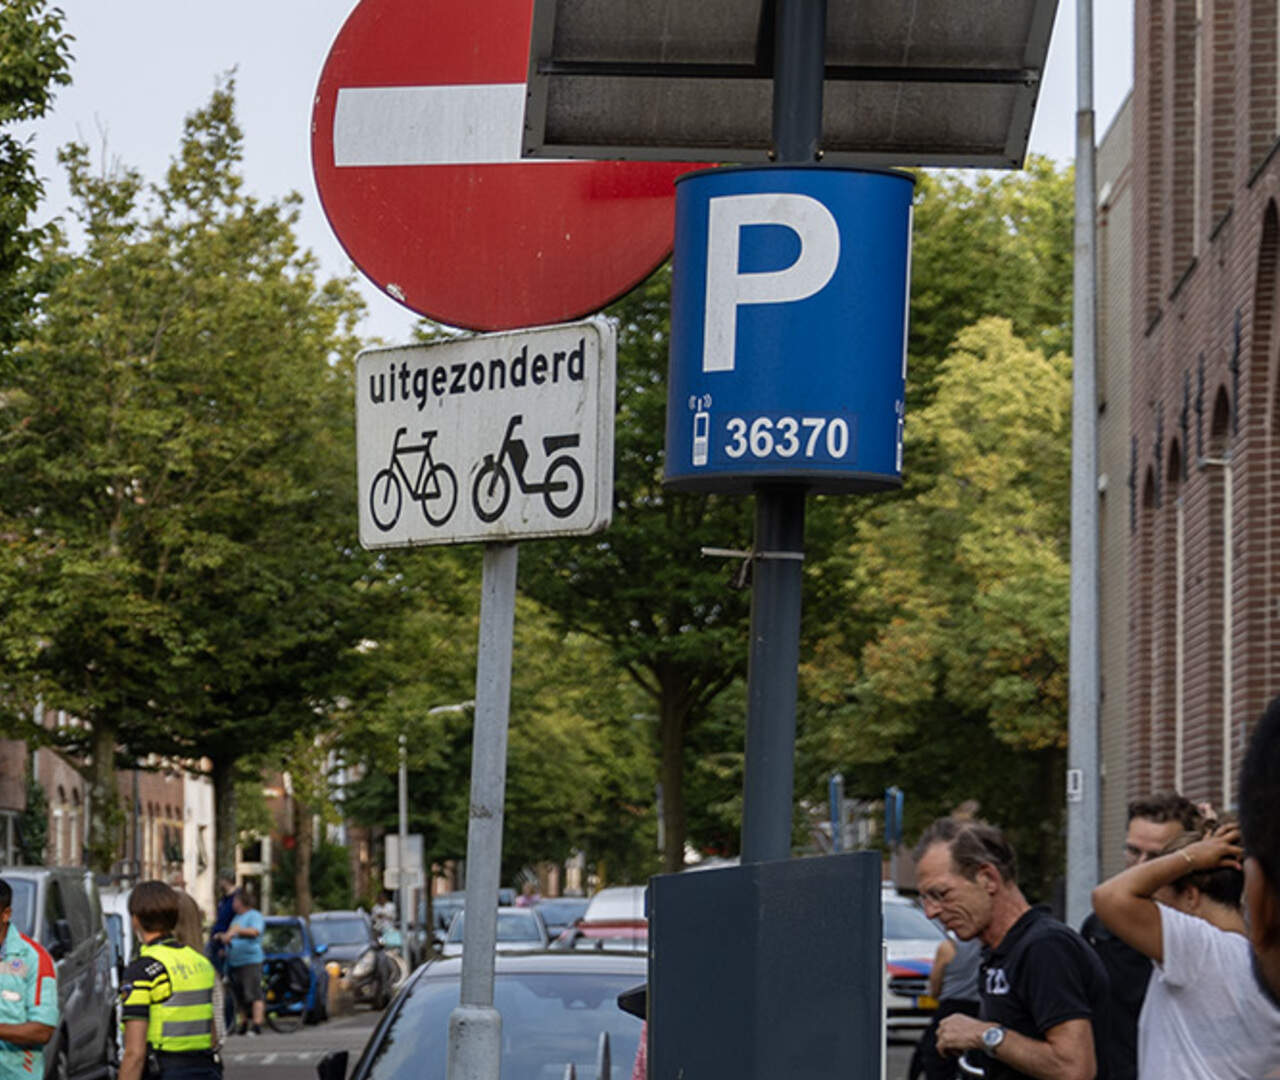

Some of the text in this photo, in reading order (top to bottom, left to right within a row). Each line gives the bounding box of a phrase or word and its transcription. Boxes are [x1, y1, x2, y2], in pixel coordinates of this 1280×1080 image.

[702, 193, 841, 373] P
[369, 338, 587, 411] uitgezonderd
[724, 416, 849, 459] 36370
